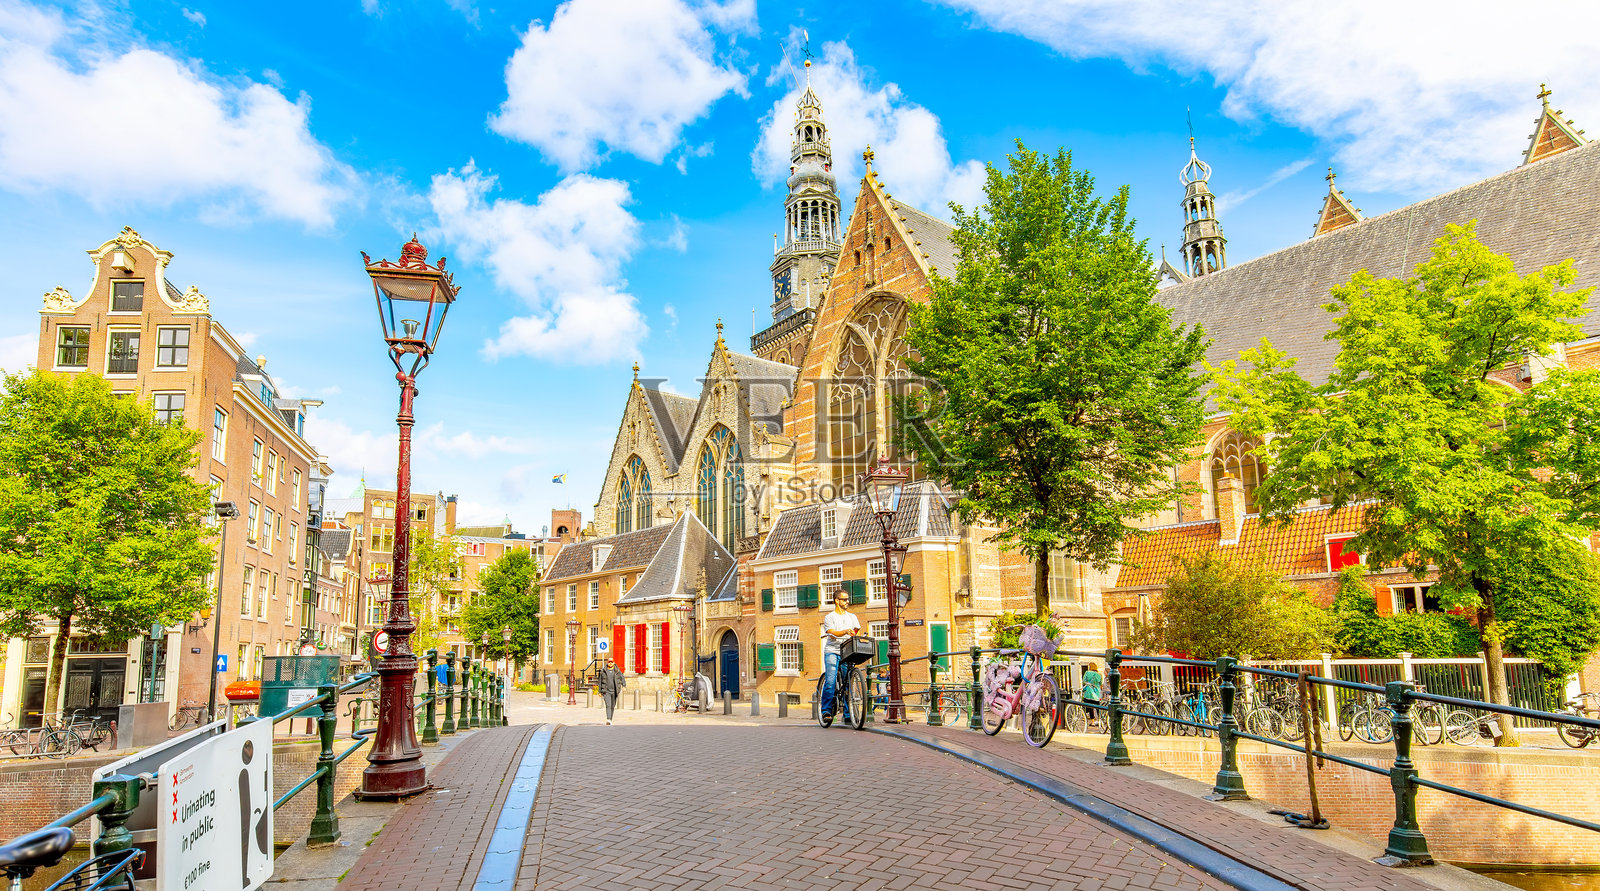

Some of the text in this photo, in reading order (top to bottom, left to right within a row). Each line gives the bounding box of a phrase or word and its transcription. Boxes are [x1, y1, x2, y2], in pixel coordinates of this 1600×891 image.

[181, 789, 216, 824] Urinating
[182, 815, 214, 854] in public
[184, 860, 211, 890] €100 fine
